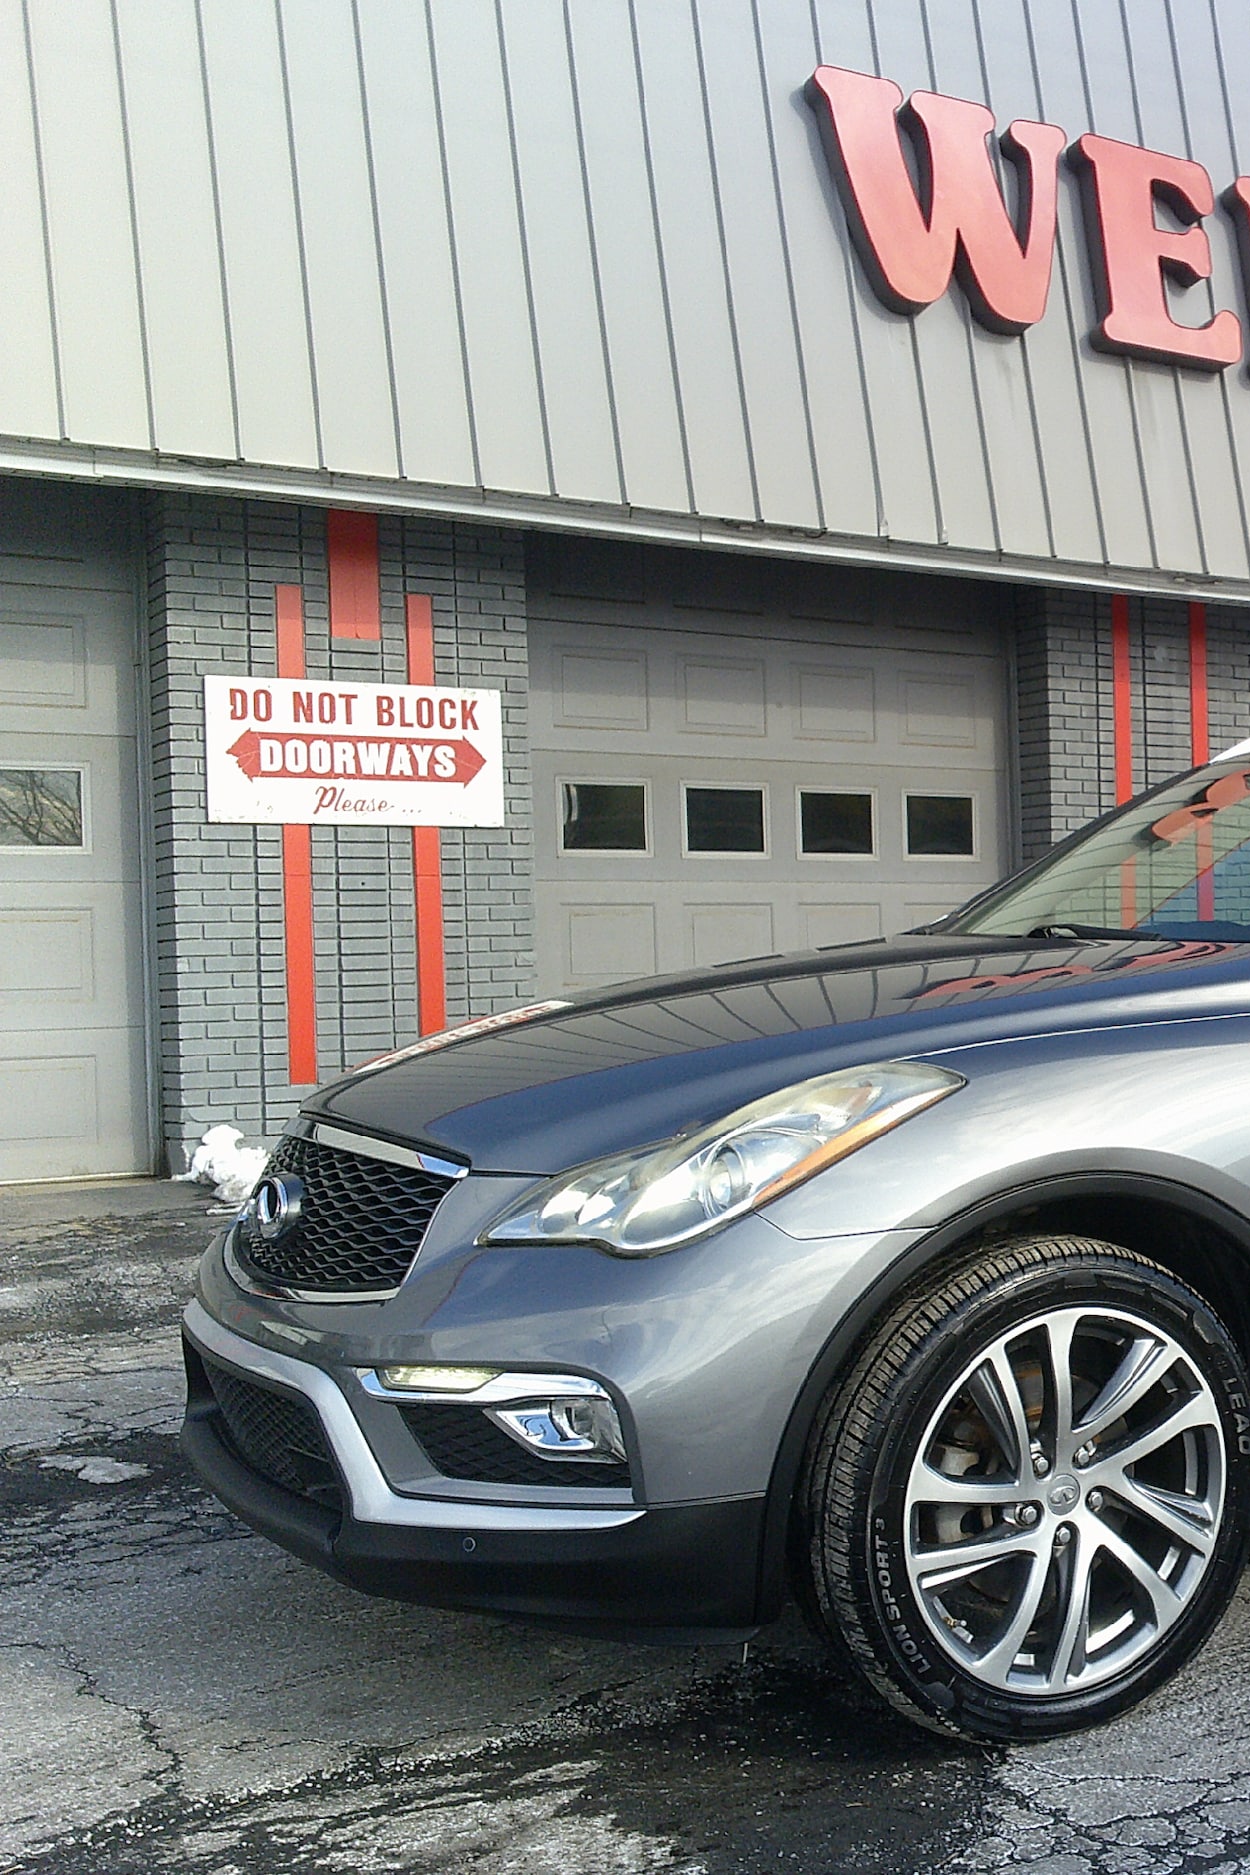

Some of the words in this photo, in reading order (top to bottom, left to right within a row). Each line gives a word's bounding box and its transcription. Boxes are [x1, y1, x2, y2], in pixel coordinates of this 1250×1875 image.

[229, 688, 273, 722] DO
[292, 691, 358, 725] NOT
[376, 695, 480, 731] BLOCK
[259, 738, 456, 778] DOORWAYS
[875, 1517, 886, 1531] 3
[875, 1534, 901, 1621] SPORT
[892, 1624, 931, 1674] LION
